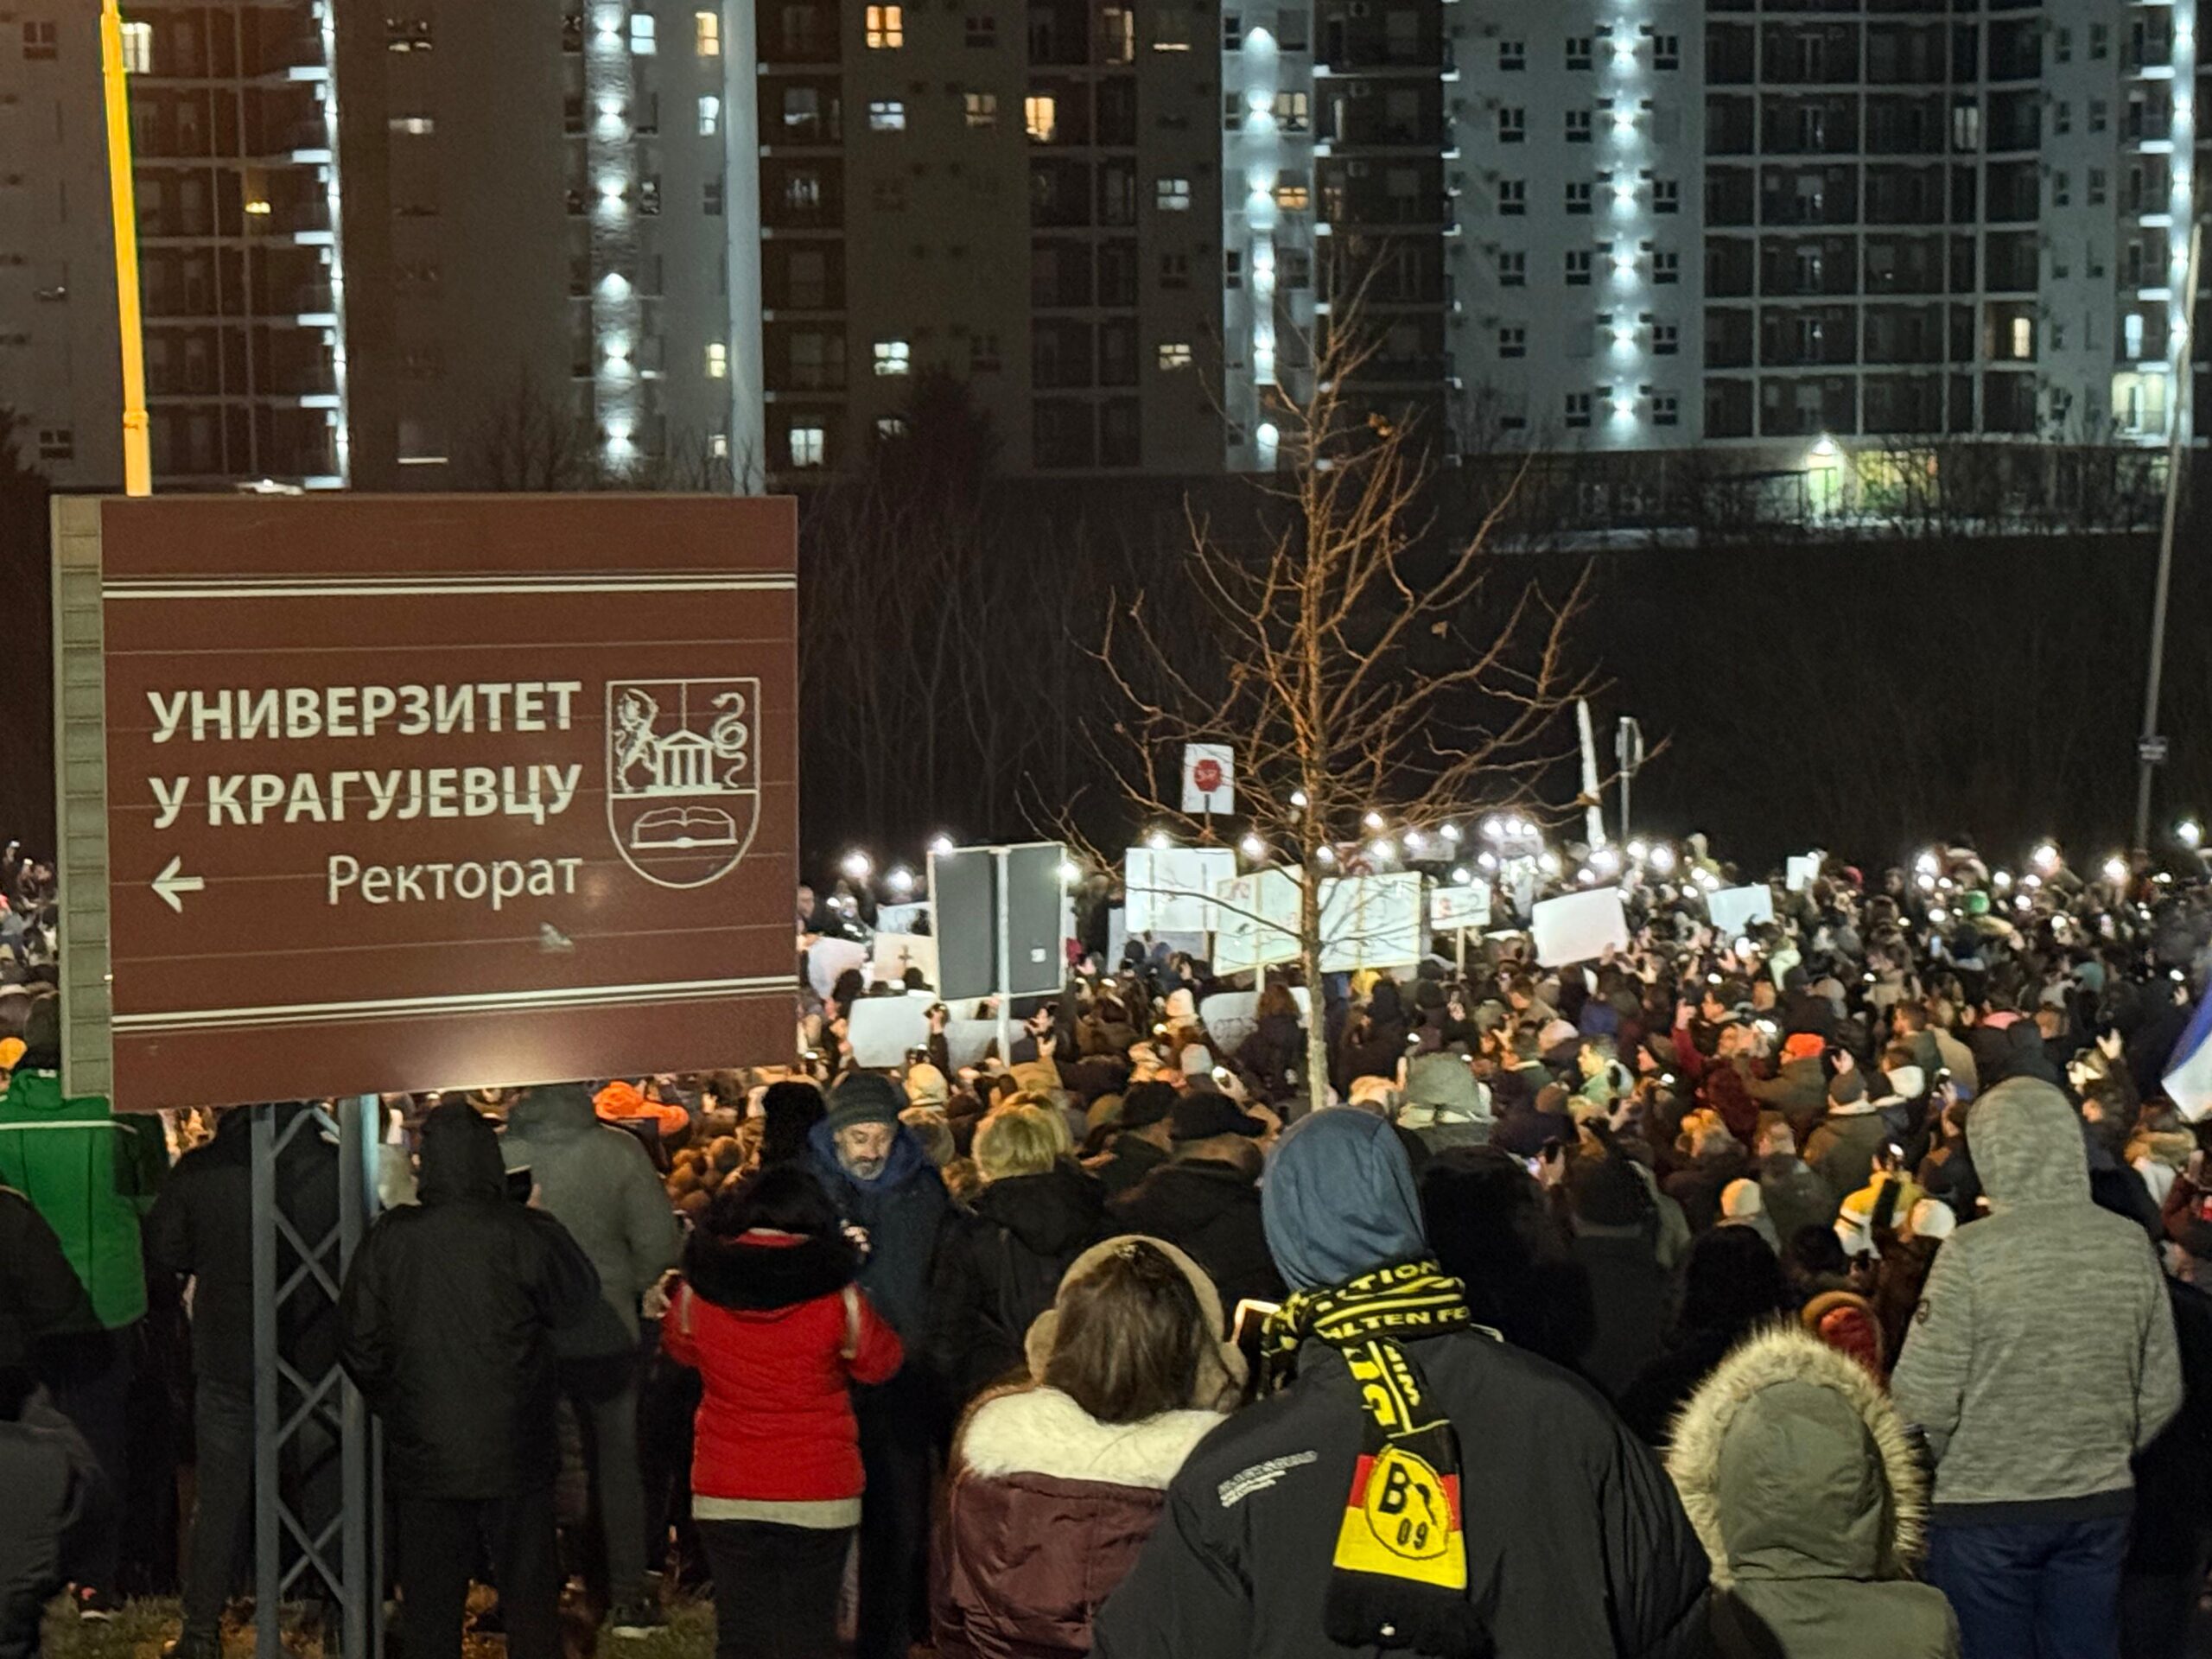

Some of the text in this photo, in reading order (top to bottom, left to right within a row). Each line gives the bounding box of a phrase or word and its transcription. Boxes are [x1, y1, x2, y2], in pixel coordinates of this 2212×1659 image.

[147, 681, 582, 744] УНИВЕРЗИТЕТ
[148, 763, 583, 830] У КРАГУЈЕВЦУ
[327, 855, 583, 910] Ректорат
[1338, 1261, 1439, 1296] TION
[1396, 1517, 1429, 1550] 09
